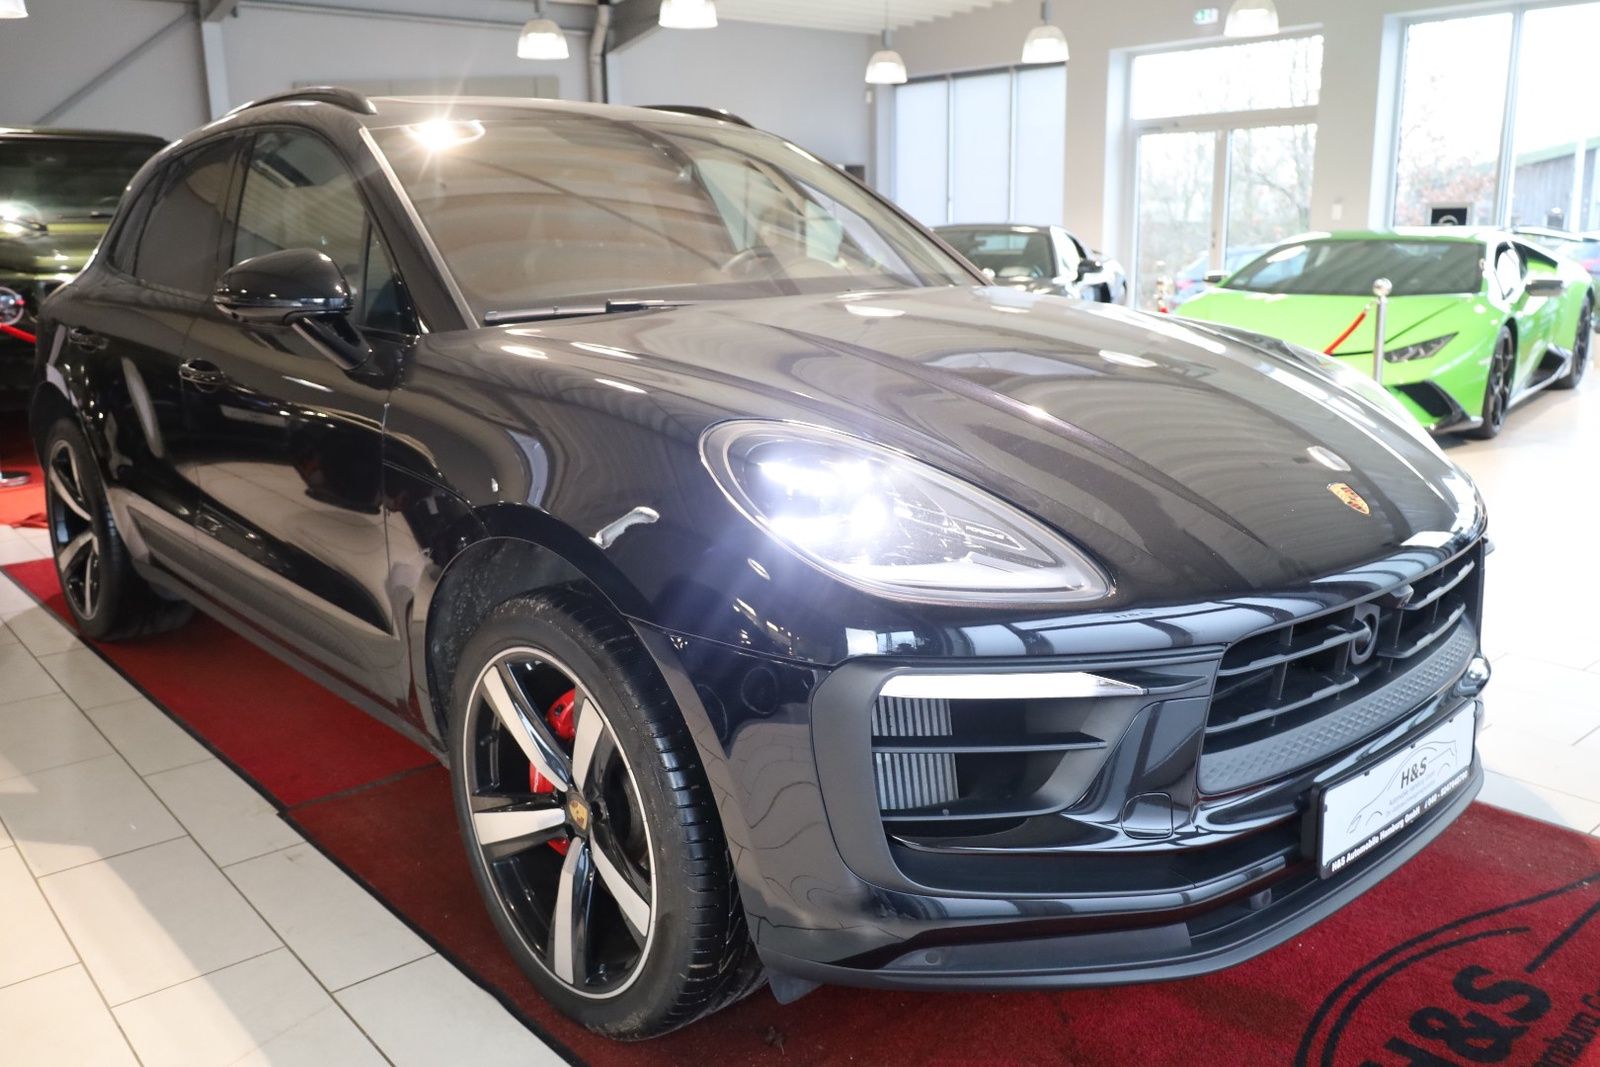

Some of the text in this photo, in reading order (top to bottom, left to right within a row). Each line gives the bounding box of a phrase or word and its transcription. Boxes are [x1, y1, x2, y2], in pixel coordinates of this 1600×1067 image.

[1400, 756, 1427, 790] H&S
[1331, 855, 1346, 873] H&S
[1345, 835, 1380, 864] Automobile
[1379, 818, 1405, 841] Hamburg
[1404, 805, 1421, 824] GmbH
